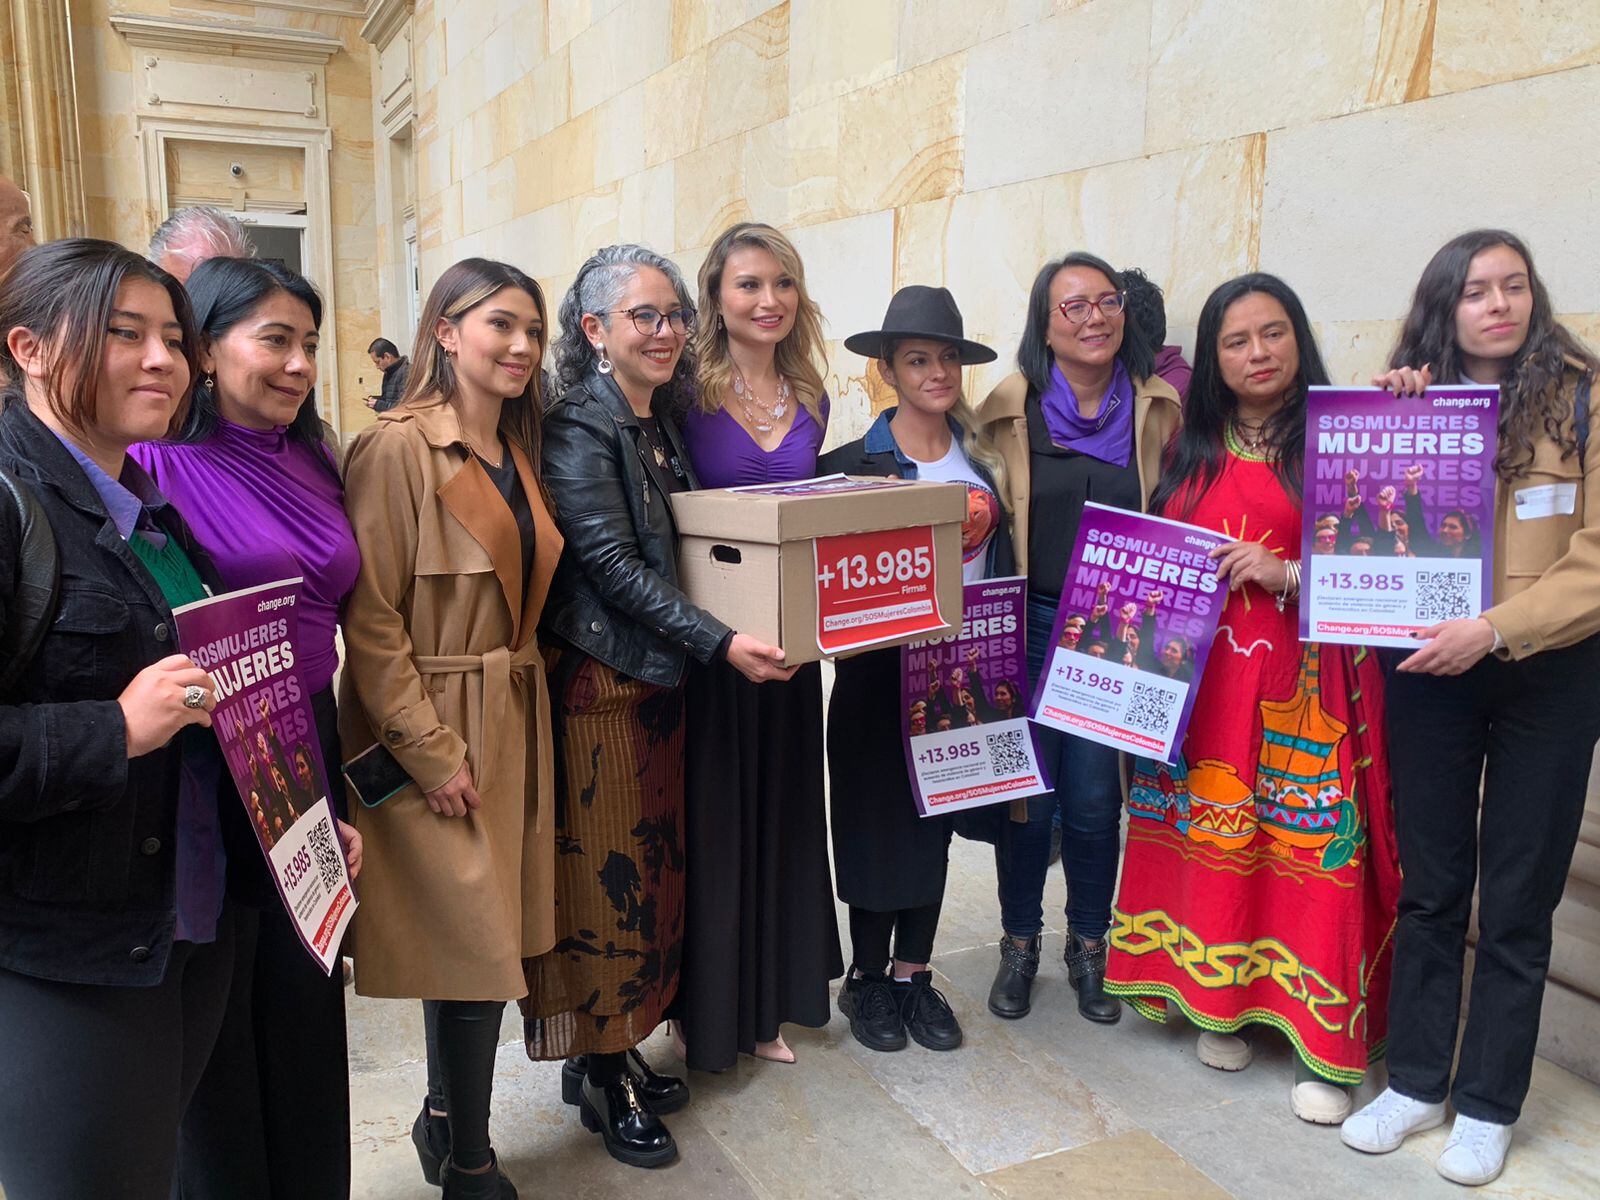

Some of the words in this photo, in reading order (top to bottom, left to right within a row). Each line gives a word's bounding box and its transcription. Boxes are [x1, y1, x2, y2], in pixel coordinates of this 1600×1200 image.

[1433, 397, 1491, 408] change.org
[1318, 415, 1479, 431] SOSMUJERES
[1318, 432, 1485, 455] MUJERES
[1316, 458, 1483, 481] MUJERES
[1087, 528, 1218, 571] SOSMUJERES
[1184, 535, 1221, 549] change.
[818, 546, 931, 590] +13.985
[1081, 543, 1219, 593] MUJERES
[901, 584, 927, 595] Firmas
[982, 586, 1021, 596] change.org
[1075, 566, 1212, 616] MUJERES
[1318, 573, 1404, 591] +13.985
[257, 594, 296, 613] change.org
[189, 618, 288, 669] SOSMUJERES
[908, 637, 1017, 672] MUJERES
[1056, 666, 1124, 694] +13.985
[918, 741, 980, 764] +13.985
[283, 844, 312, 892] +13.985
